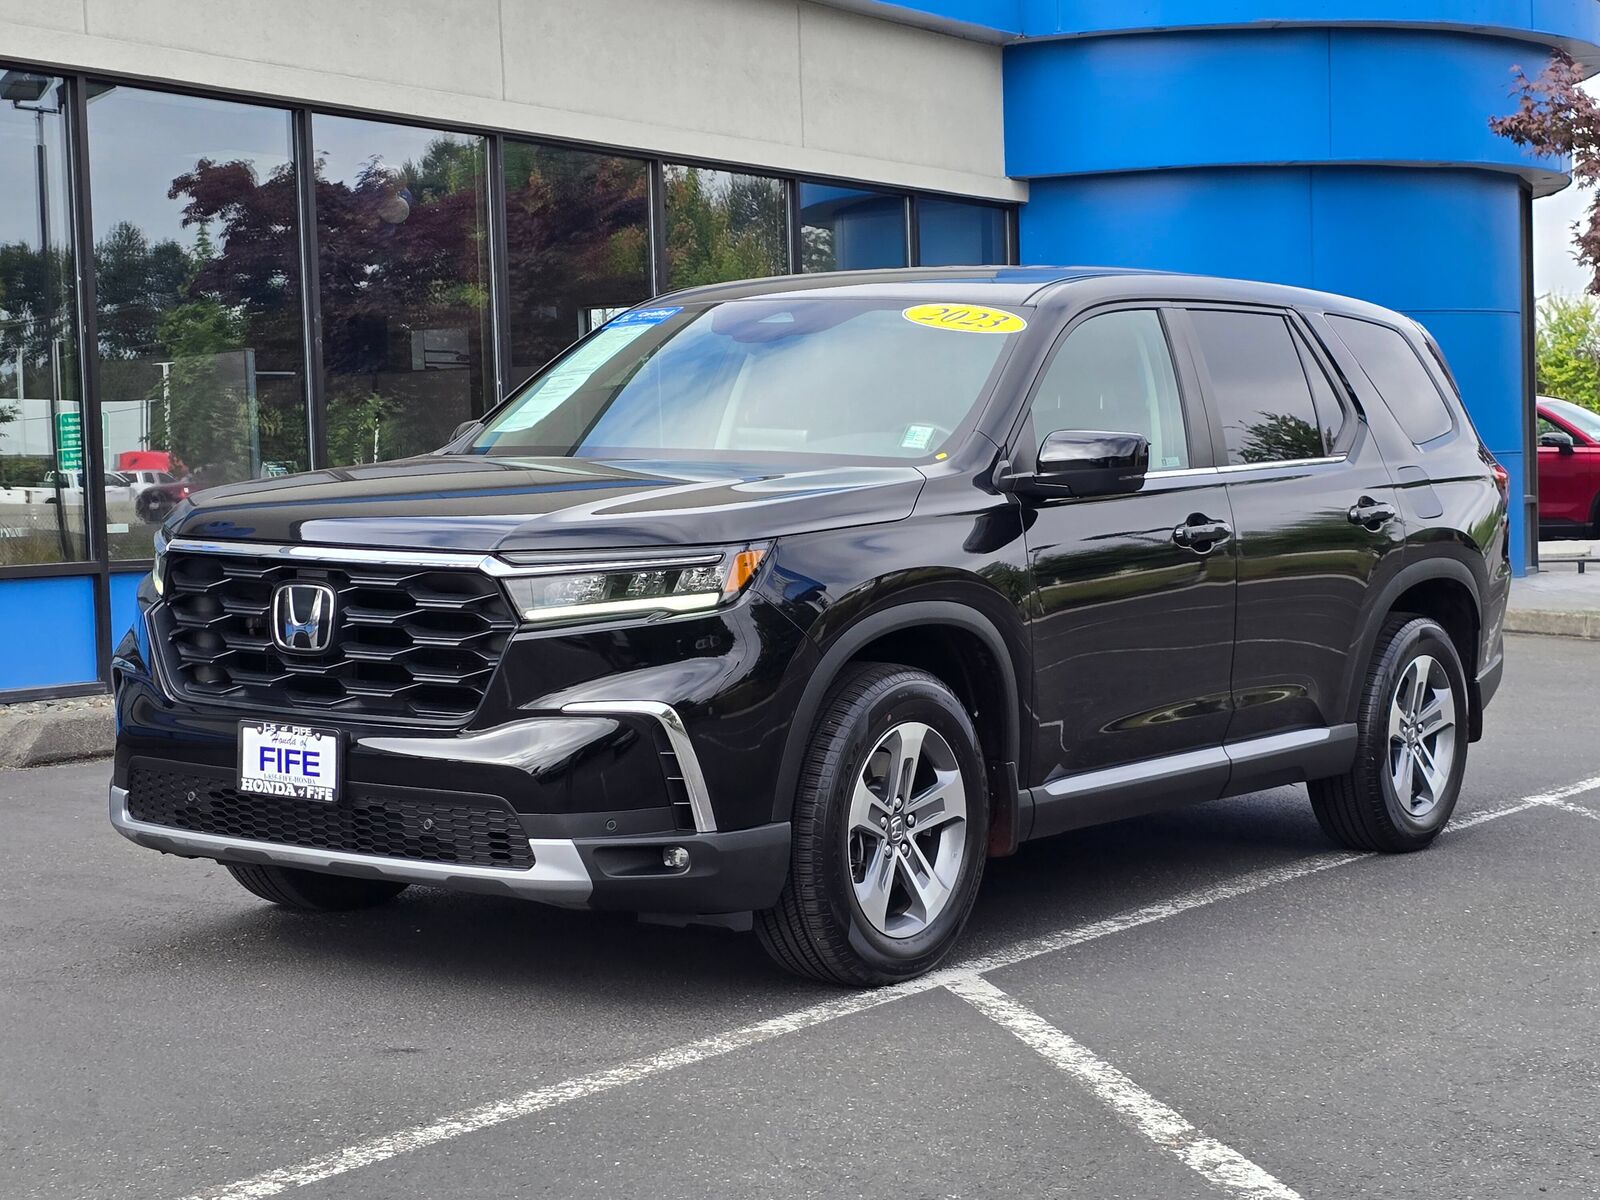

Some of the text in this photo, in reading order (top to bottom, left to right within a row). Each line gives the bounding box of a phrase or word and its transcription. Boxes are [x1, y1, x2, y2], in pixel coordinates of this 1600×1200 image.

[918, 308, 1010, 328] 2023
[271, 732, 309, 750] Honda of
[260, 746, 320, 777] FIFE
[241, 777, 297, 797] HONDA
[306, 785, 333, 801] FIFE
